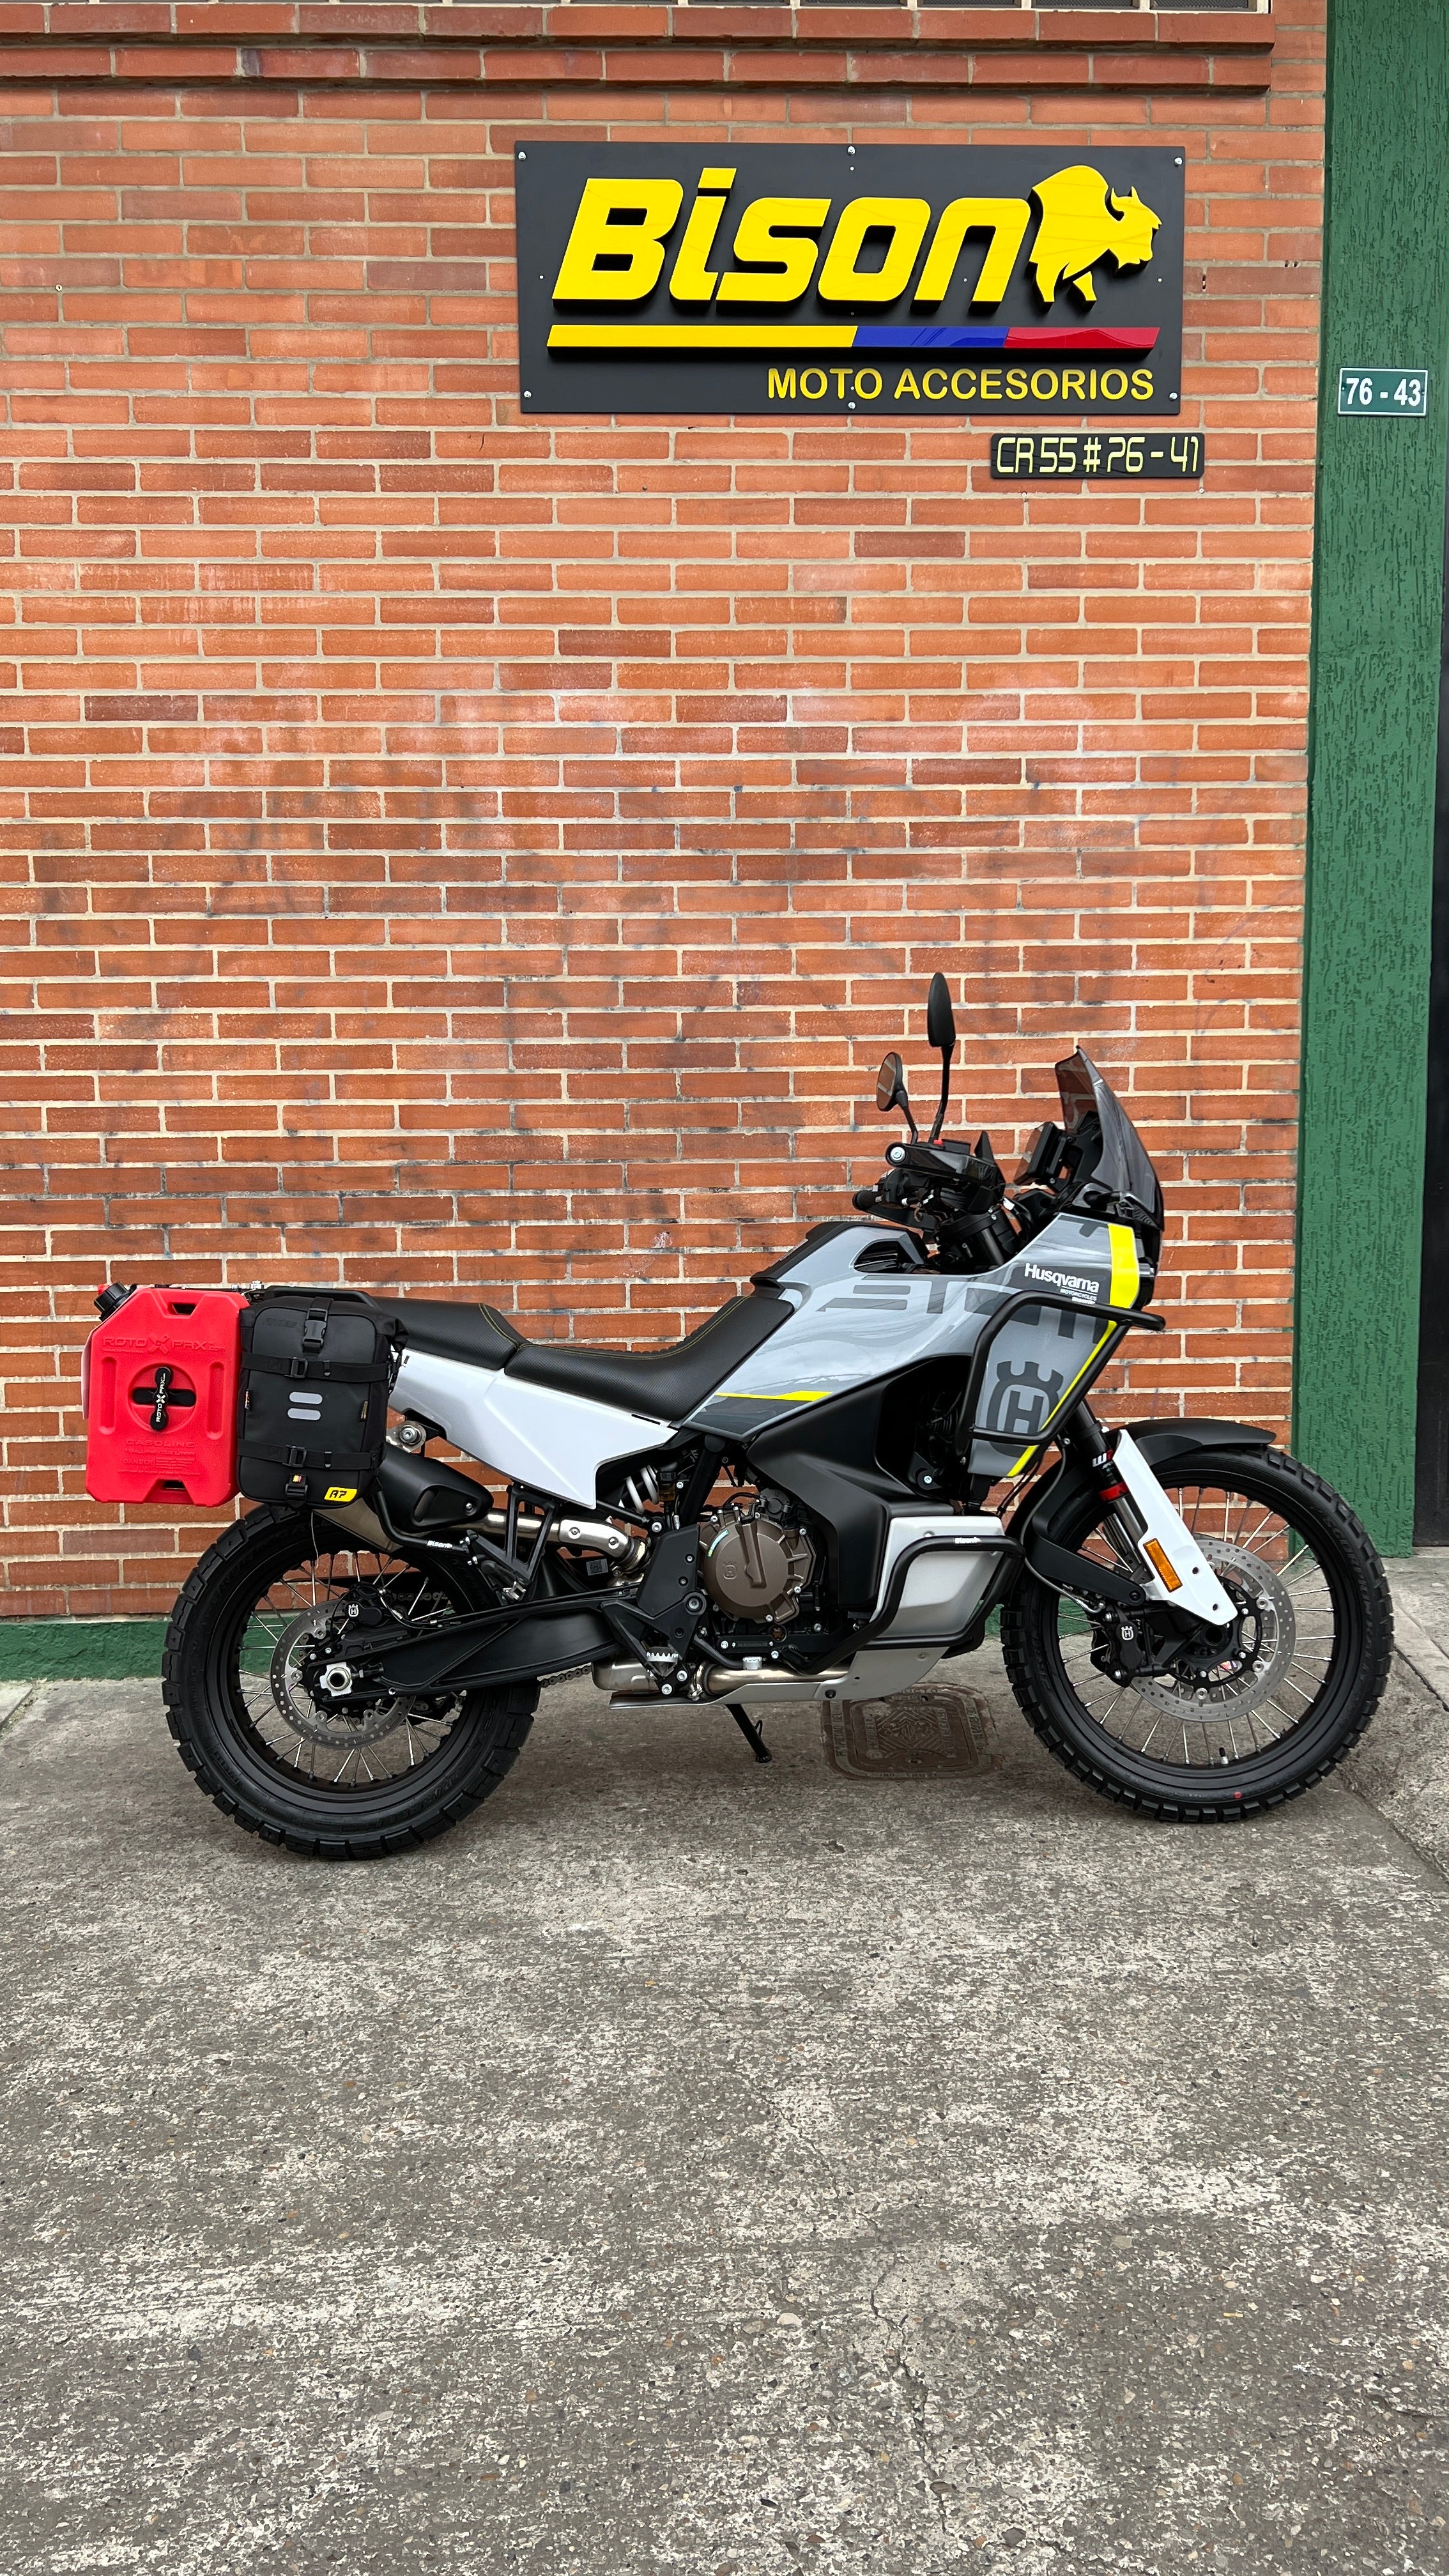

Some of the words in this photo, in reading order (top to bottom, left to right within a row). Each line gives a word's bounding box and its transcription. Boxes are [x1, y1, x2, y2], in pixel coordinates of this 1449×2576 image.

[552, 167, 1031, 302] Bison
[767, 367, 882, 400] MOTO
[894, 367, 1154, 400] ACCESORIOS
[1024, 1262, 1100, 1293] Husqvarna
[1059, 1288, 1098, 1301] MOTORCYCLES
[125, 1439, 195, 1448] GASOLINE
